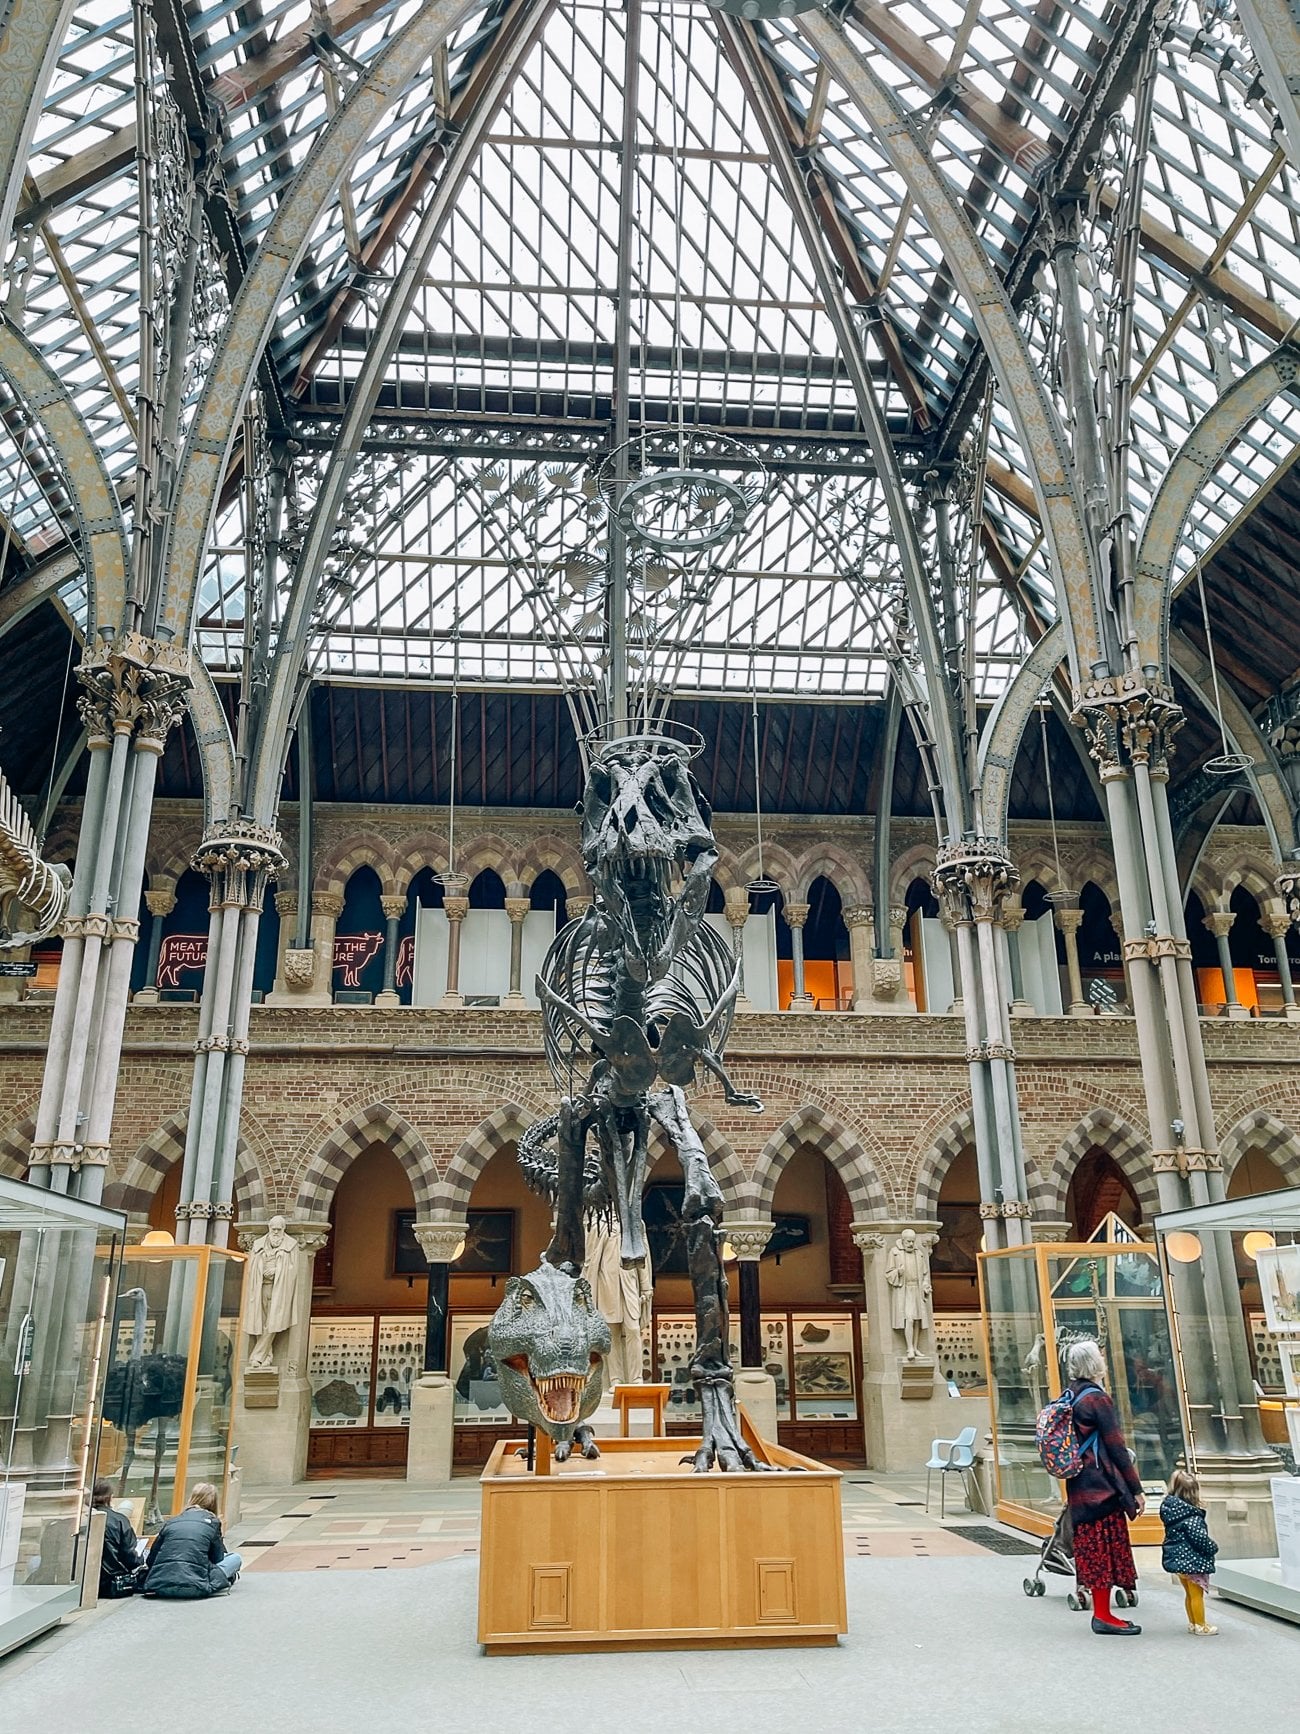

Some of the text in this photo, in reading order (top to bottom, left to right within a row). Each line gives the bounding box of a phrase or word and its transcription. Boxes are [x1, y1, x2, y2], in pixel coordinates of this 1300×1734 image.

[170, 942, 203, 951] MEAT
[344, 943, 367, 952] THE
[169, 952, 207, 961] FUTUR
[1093, 951, 1102, 961] A
